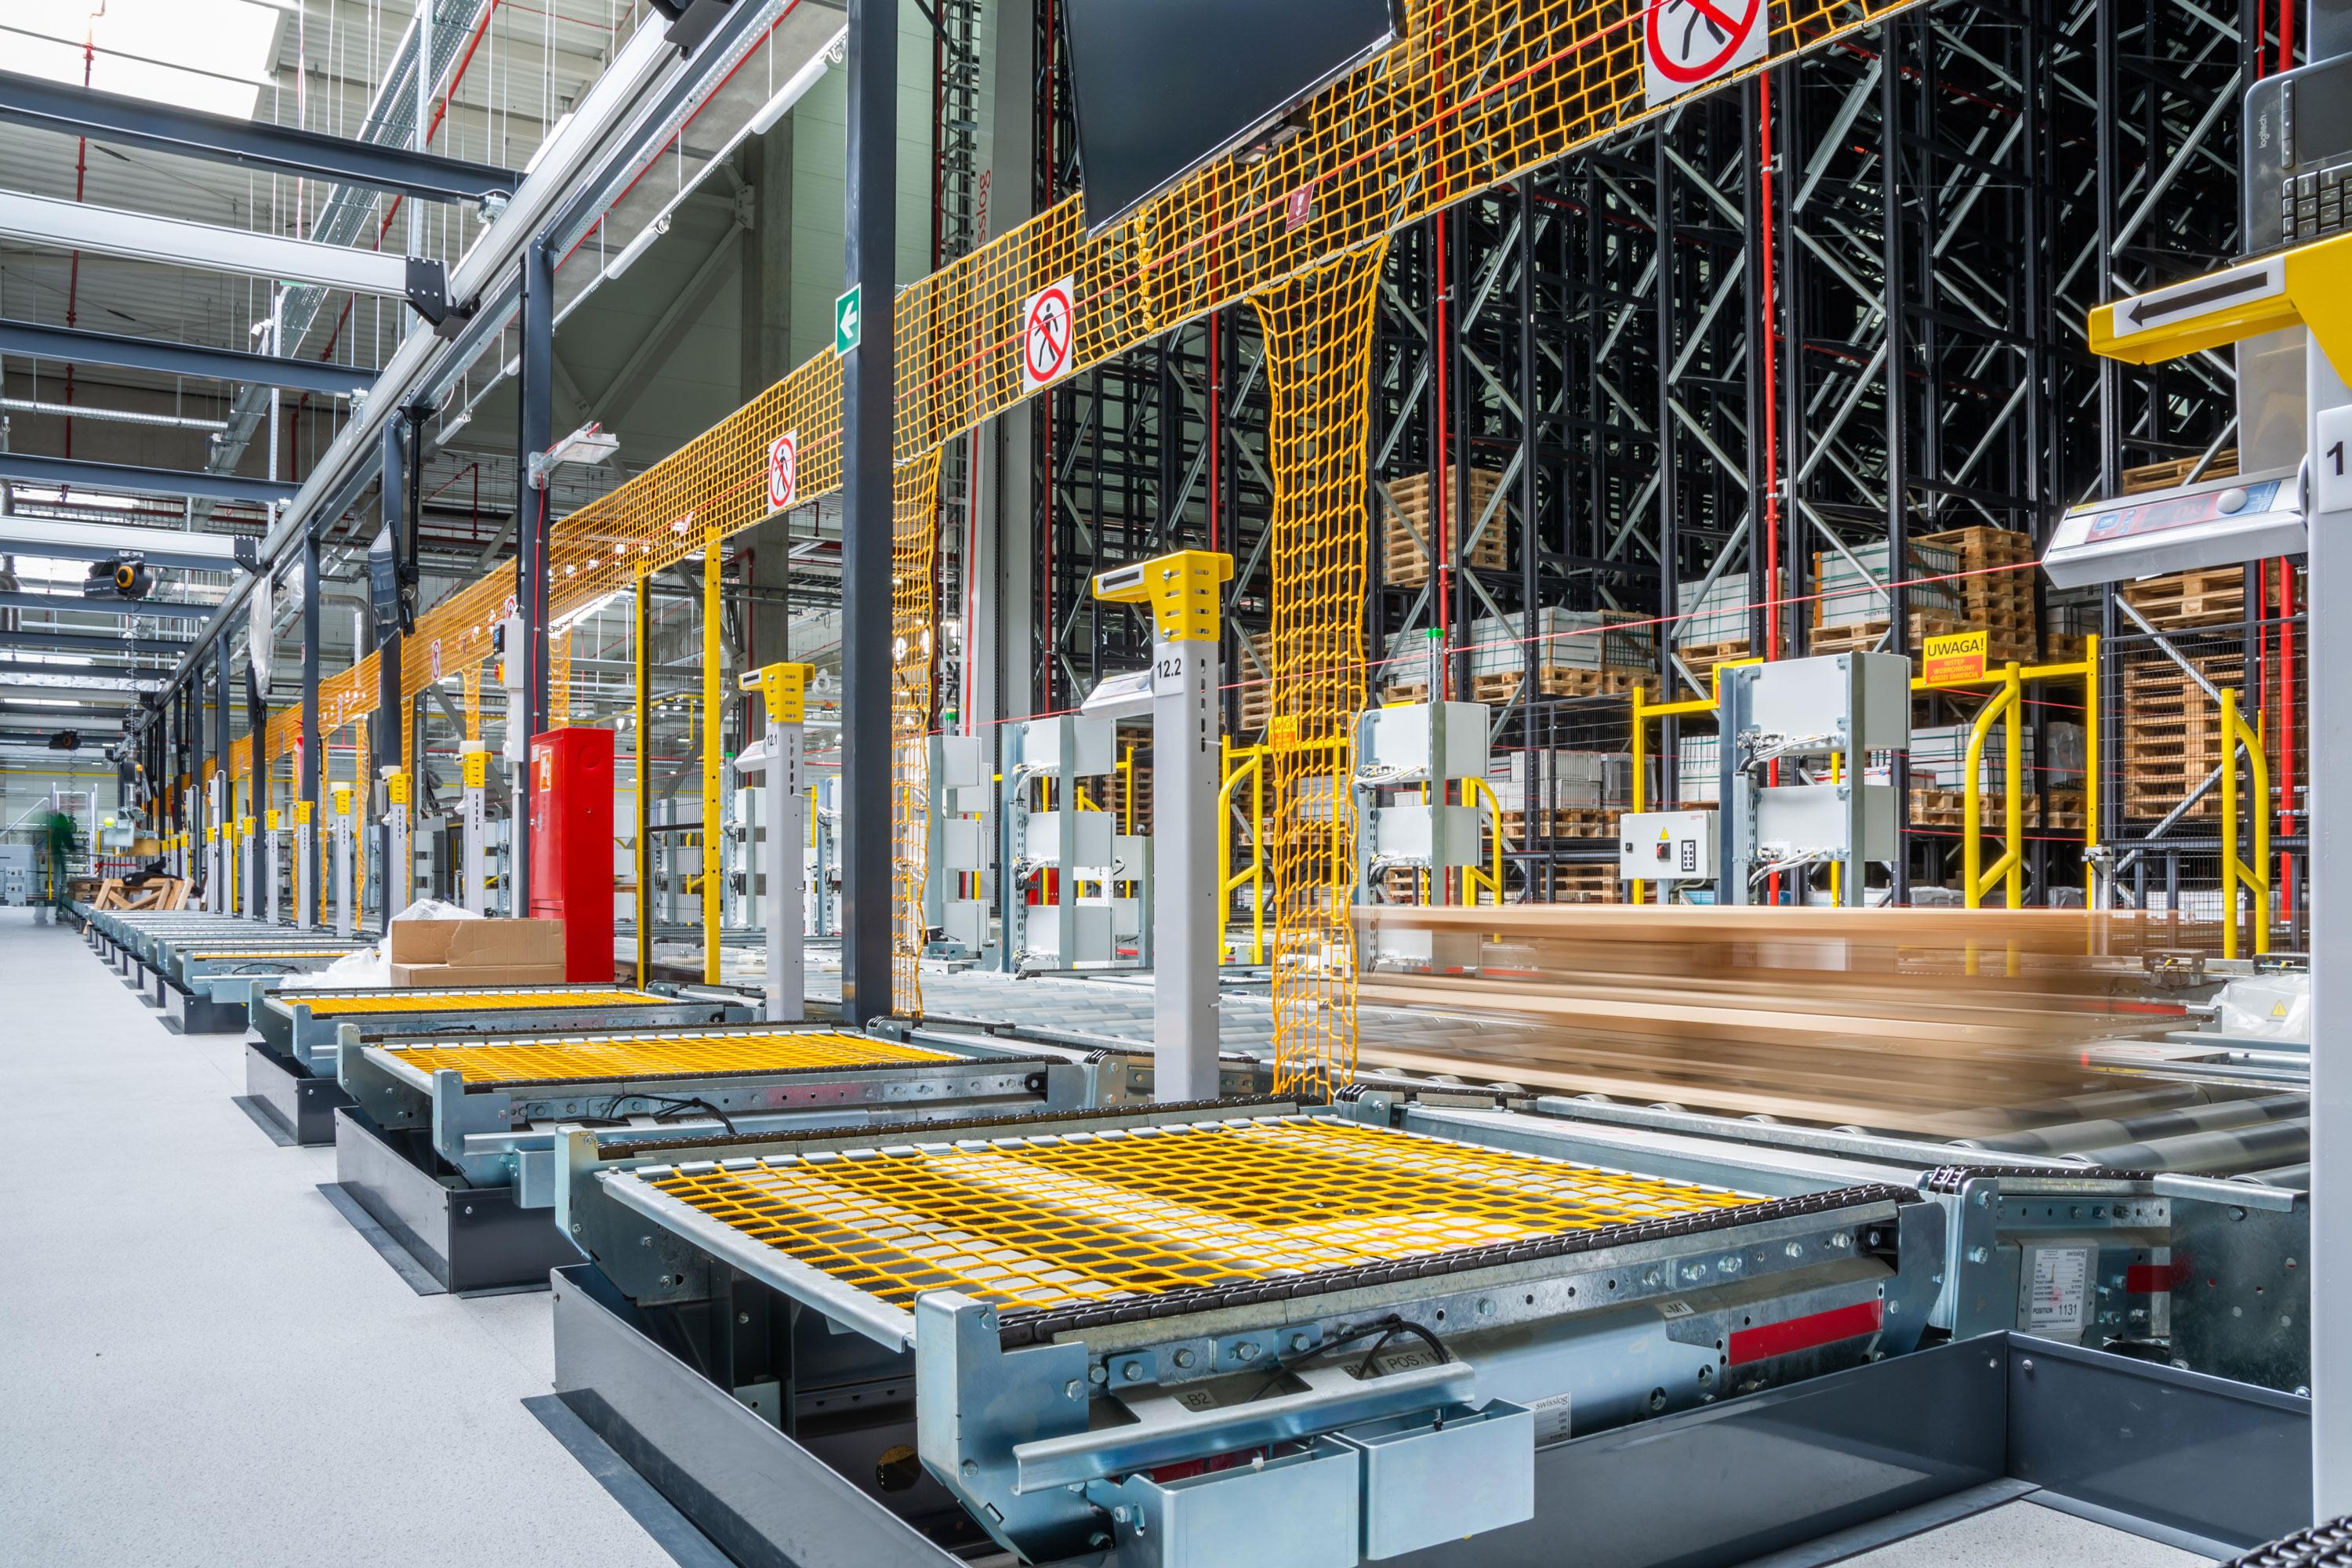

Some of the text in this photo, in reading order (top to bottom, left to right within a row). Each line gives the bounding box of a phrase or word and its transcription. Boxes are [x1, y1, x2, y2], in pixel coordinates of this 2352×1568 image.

[2259, 114, 2270, 149] logitech
[1928, 637, 1984, 657] UWAGA!
[1157, 658, 1181, 679] 12.2
[1933, 664, 1976, 675] WZBRONIONY
[767, 733, 778, 746] 12.1
[2058, 1303, 2077, 1316] 1131
[1536, 1396, 1568, 1410] swisslog
